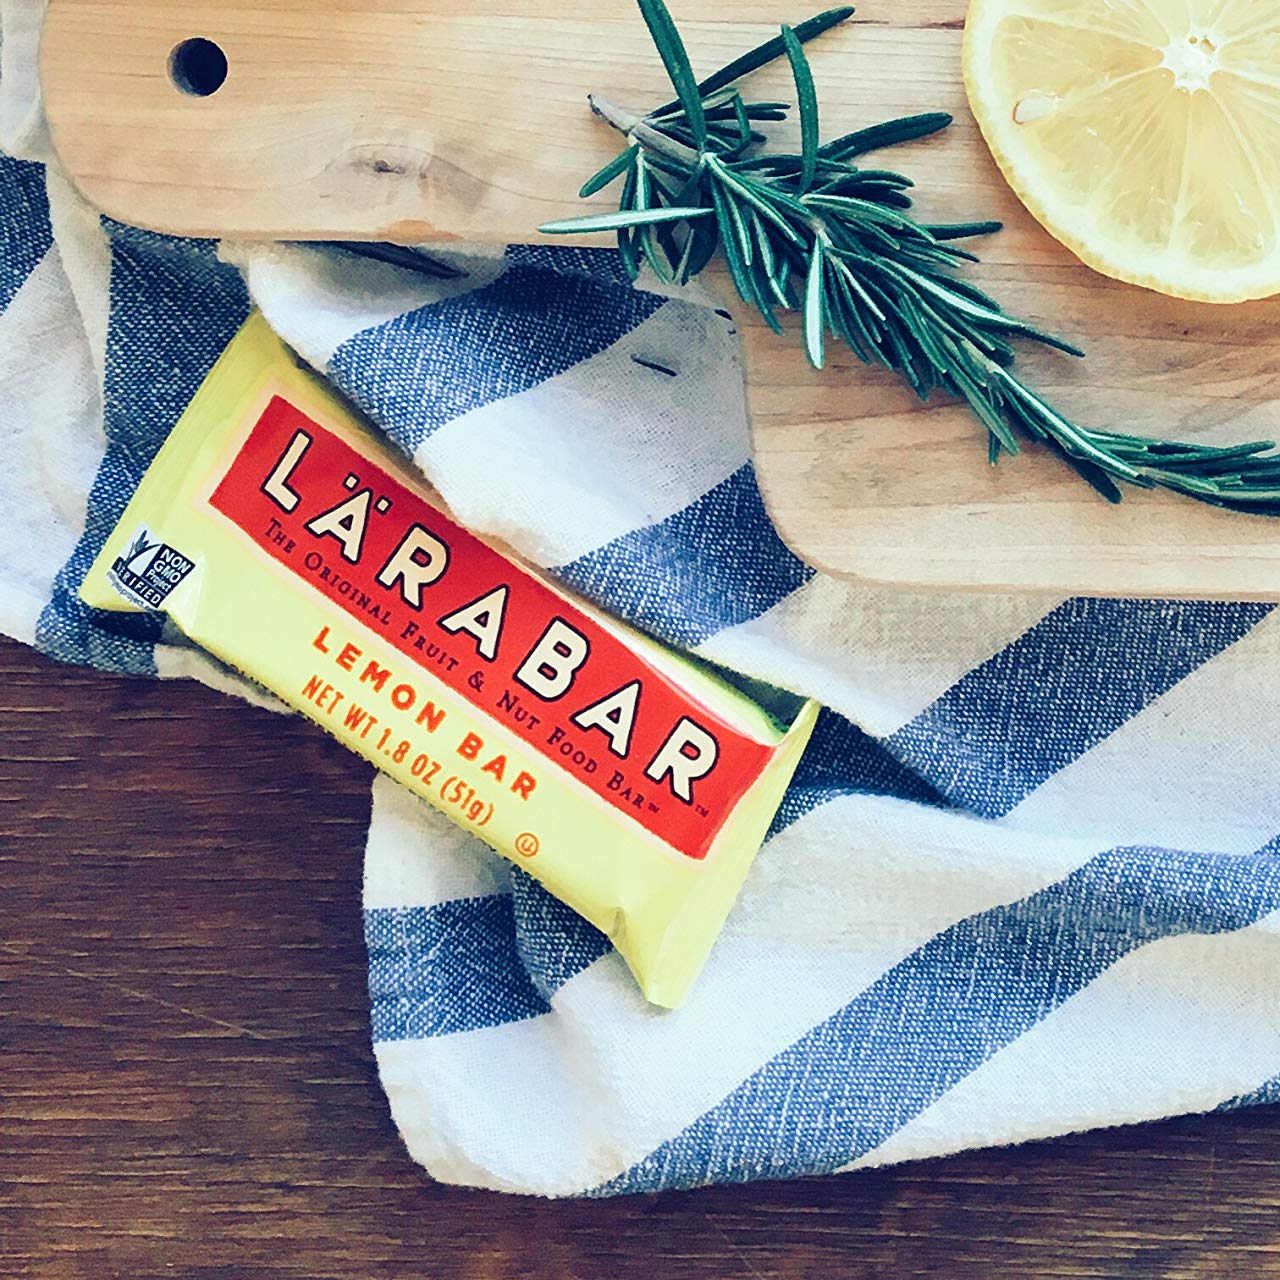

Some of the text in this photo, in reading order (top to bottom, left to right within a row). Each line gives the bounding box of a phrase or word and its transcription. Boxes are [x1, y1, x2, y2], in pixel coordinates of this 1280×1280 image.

[153, 559, 181, 584] GMO
[159, 548, 191, 574] NON
[467, 670, 485, 692] &
[312, 625, 537, 801] LEMON BAR
[301, 674, 495, 826] NET WT 1.8 OZ (51g)
